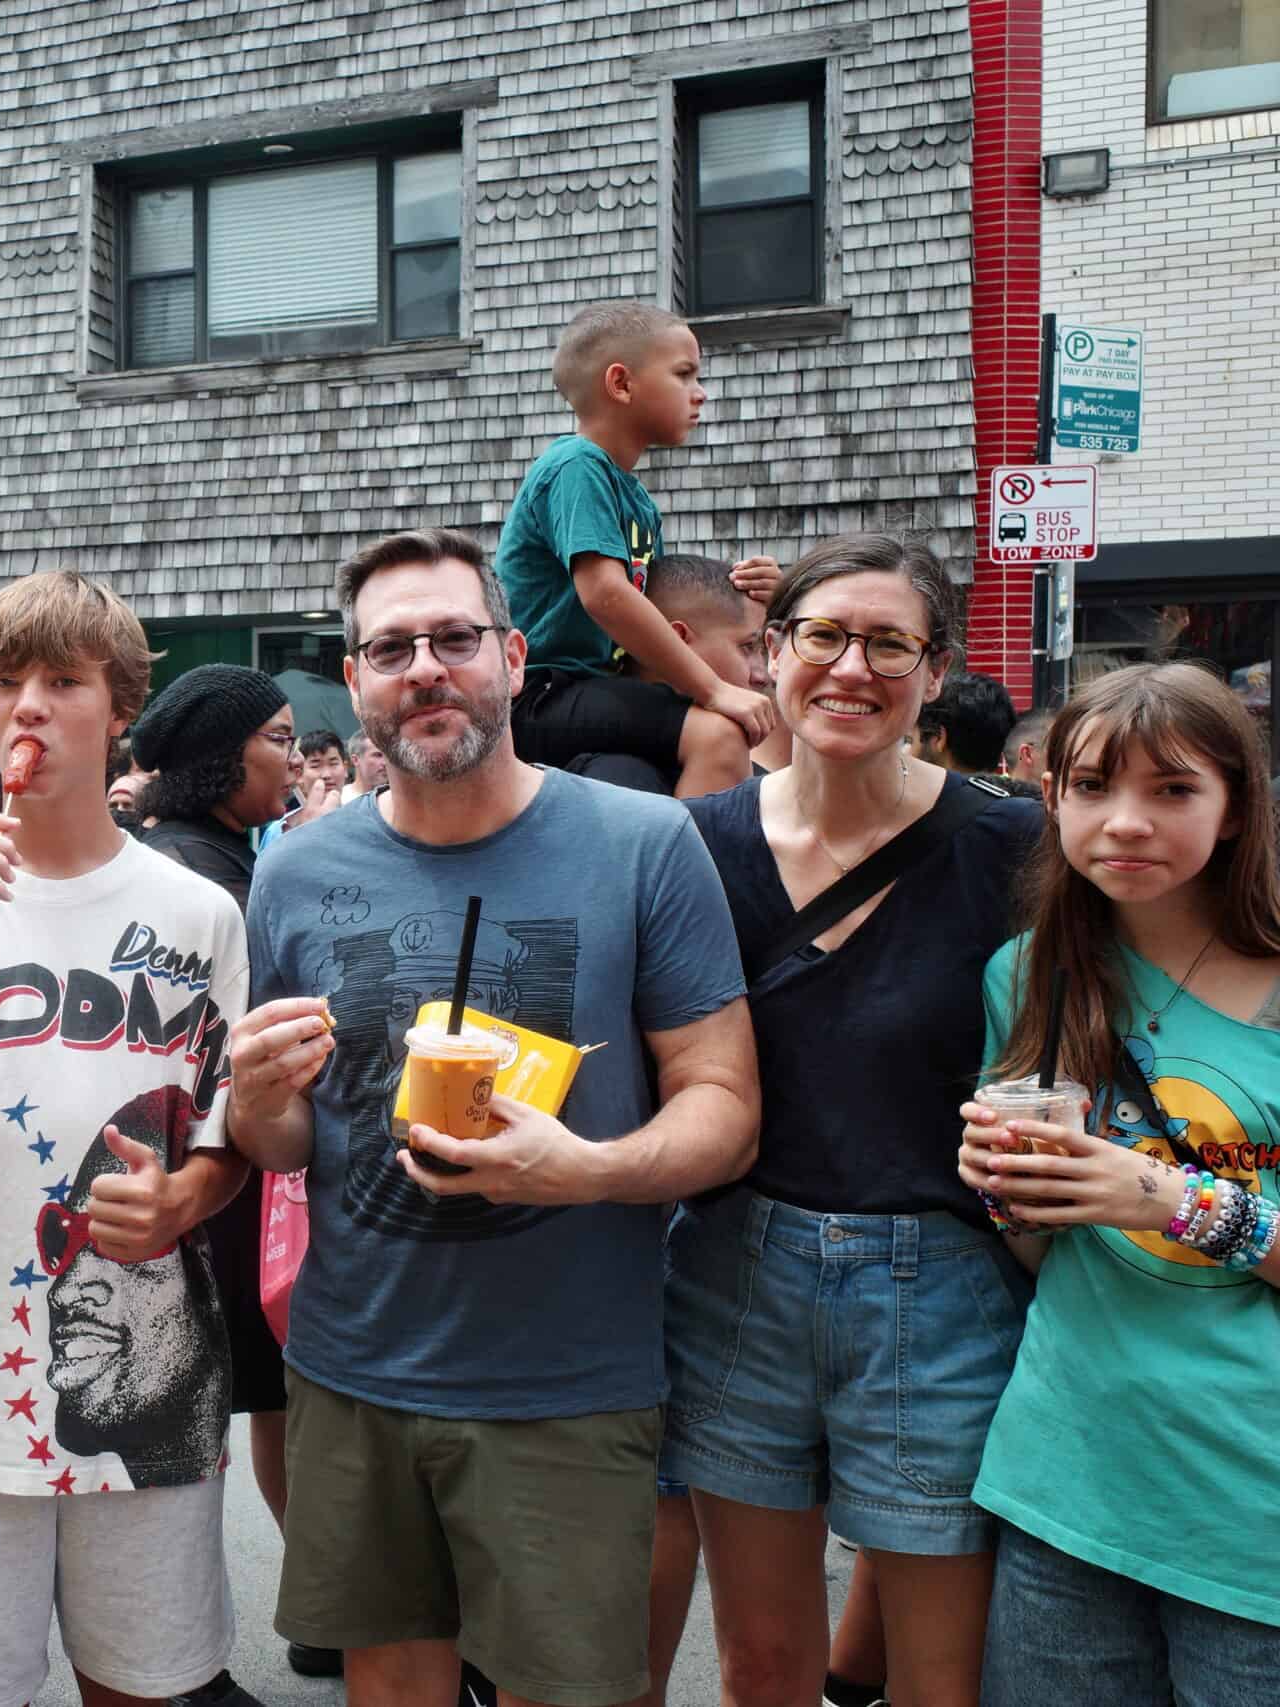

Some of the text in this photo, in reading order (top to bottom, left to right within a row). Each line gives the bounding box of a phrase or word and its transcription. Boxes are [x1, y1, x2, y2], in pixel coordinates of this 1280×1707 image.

[1115, 349, 1131, 358] DAY
[1063, 367, 1137, 380] PAY AT PAY BOX
[1073, 403, 1137, 420] ParkChicago
[1079, 435, 1103, 449] 535
[1106, 437, 1129, 451] 725
[1036, 511, 1072, 526] BUS
[1035, 527, 1081, 542] STOP
[999, 546, 1086, 560] TOW ZONE
